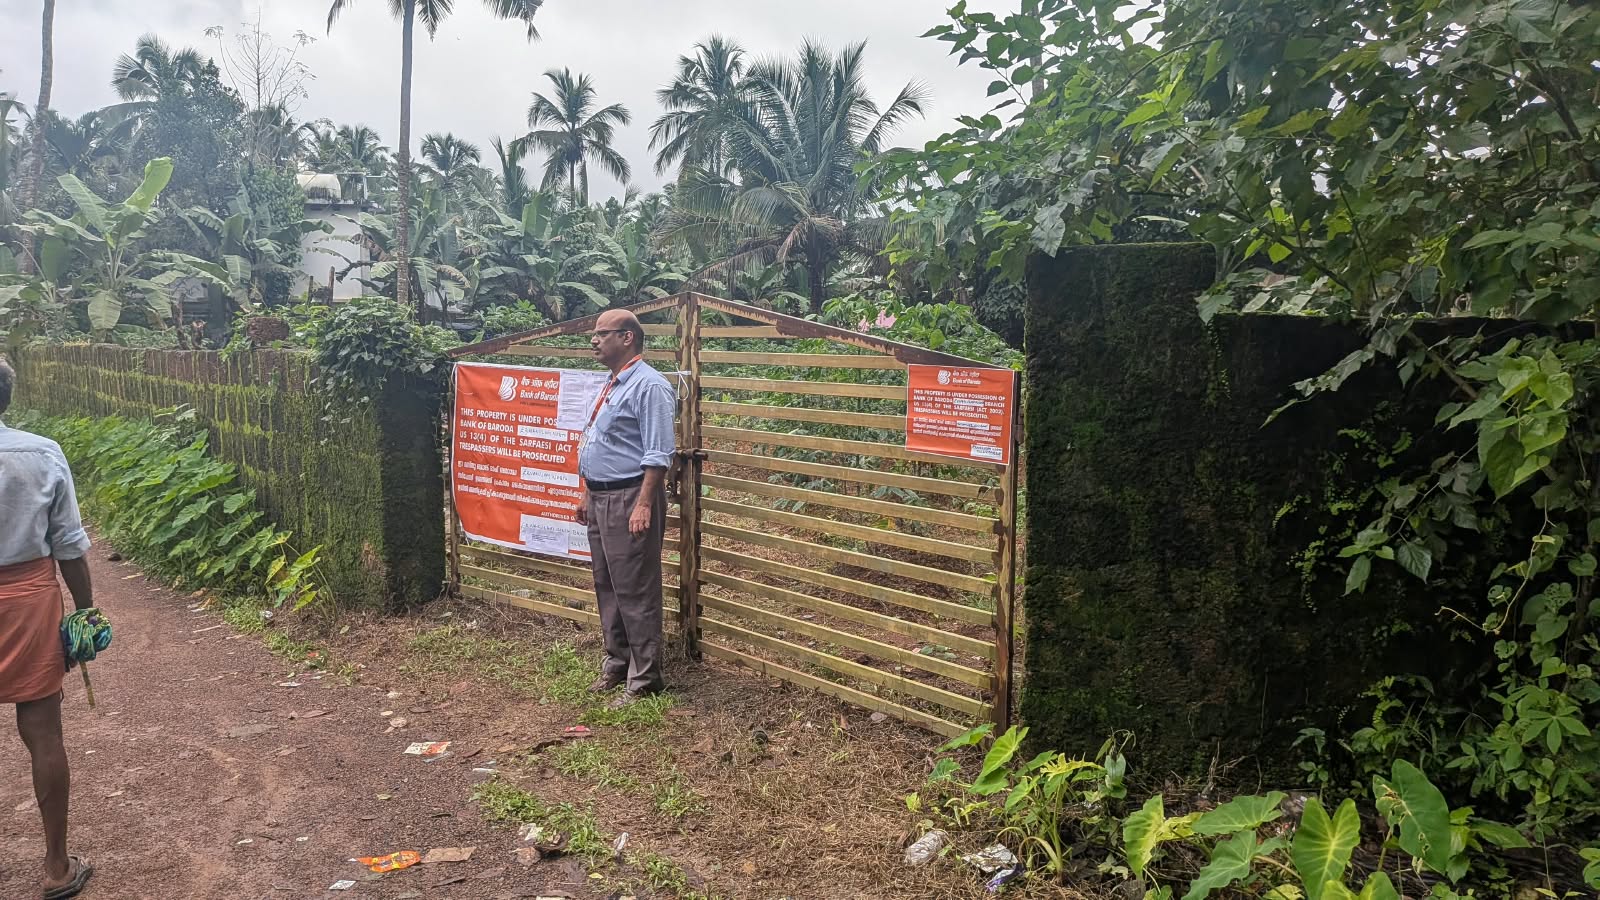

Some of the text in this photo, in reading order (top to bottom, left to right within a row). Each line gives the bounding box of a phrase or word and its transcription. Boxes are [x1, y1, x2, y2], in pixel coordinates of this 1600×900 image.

[520, 389, 534, 399] Bank
[534, 390, 540, 400] of
[924, 389, 946, 397] PROPERTY
[461, 408, 474, 416] THIS
[477, 410, 507, 421] PROPERTY
[510, 413, 516, 422] IS
[518, 415, 541, 425] UNDER
[913, 407, 941, 415] TRESPASSERS
[460, 419, 514, 433] BANK OF BARODA
[470, 432, 487, 443] 13(4)
[490, 435, 500, 443] OF
[503, 436, 516, 445] THE
[519, 438, 551, 450] SARFAESI
[555, 443, 572, 453] (ACT
[459, 442, 566, 463] TRESPASSERS WILL BE PROSECUTED
